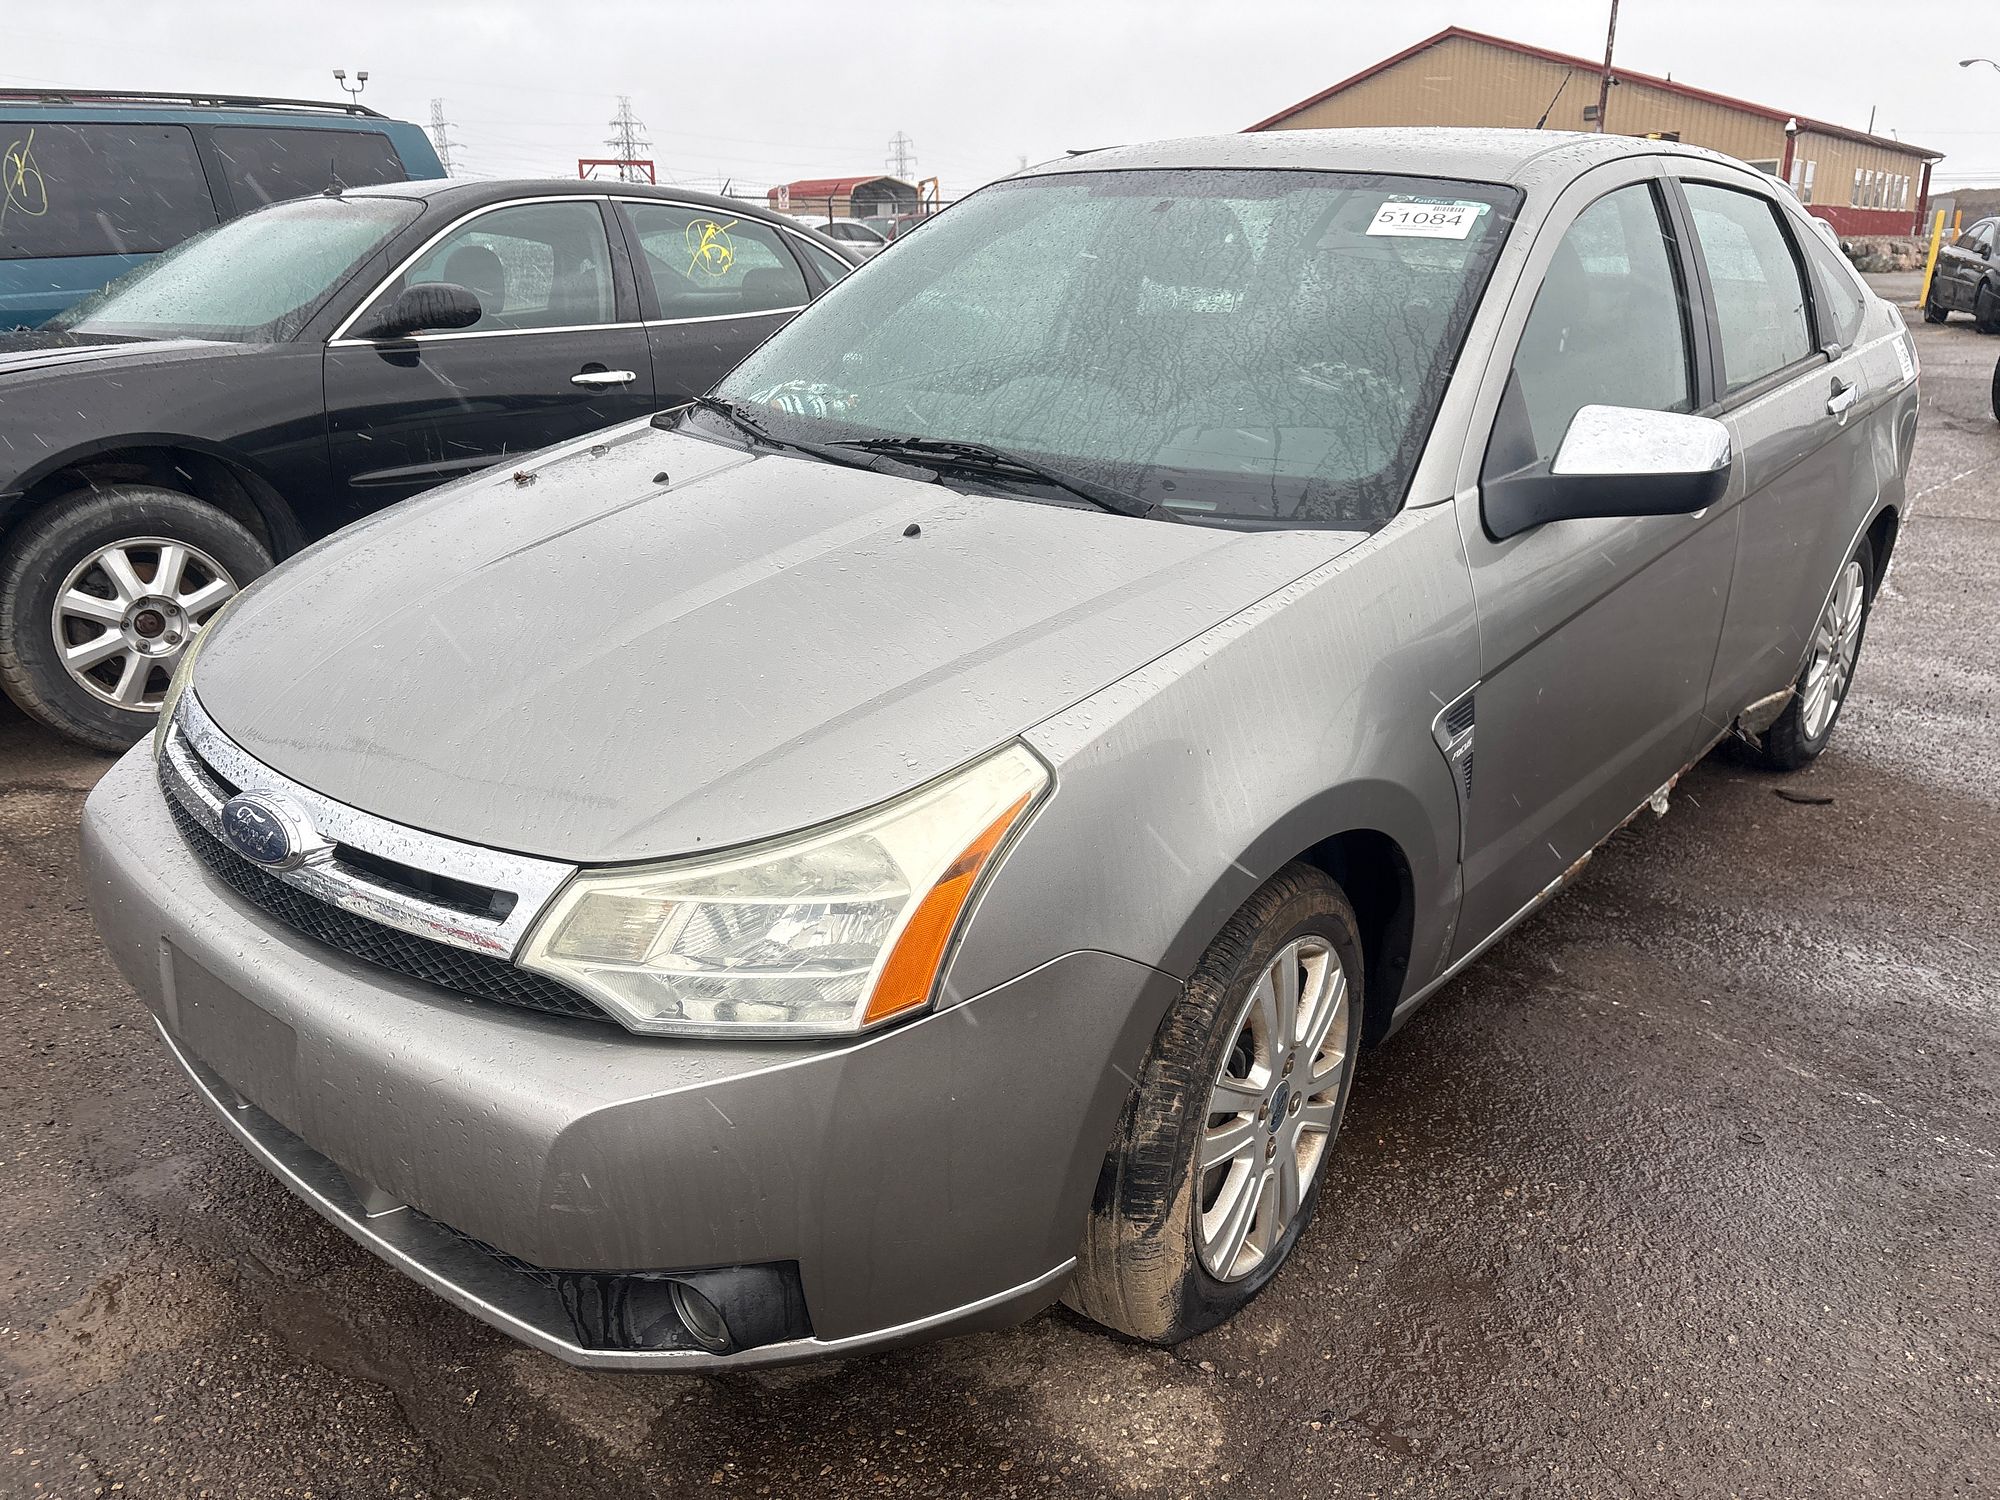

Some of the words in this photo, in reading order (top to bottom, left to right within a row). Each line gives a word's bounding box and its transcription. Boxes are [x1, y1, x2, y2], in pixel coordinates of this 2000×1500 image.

[1378, 211, 1462, 226] 51084
[1451, 737, 1473, 761] FOCUS
[229, 806, 274, 853] Ford
